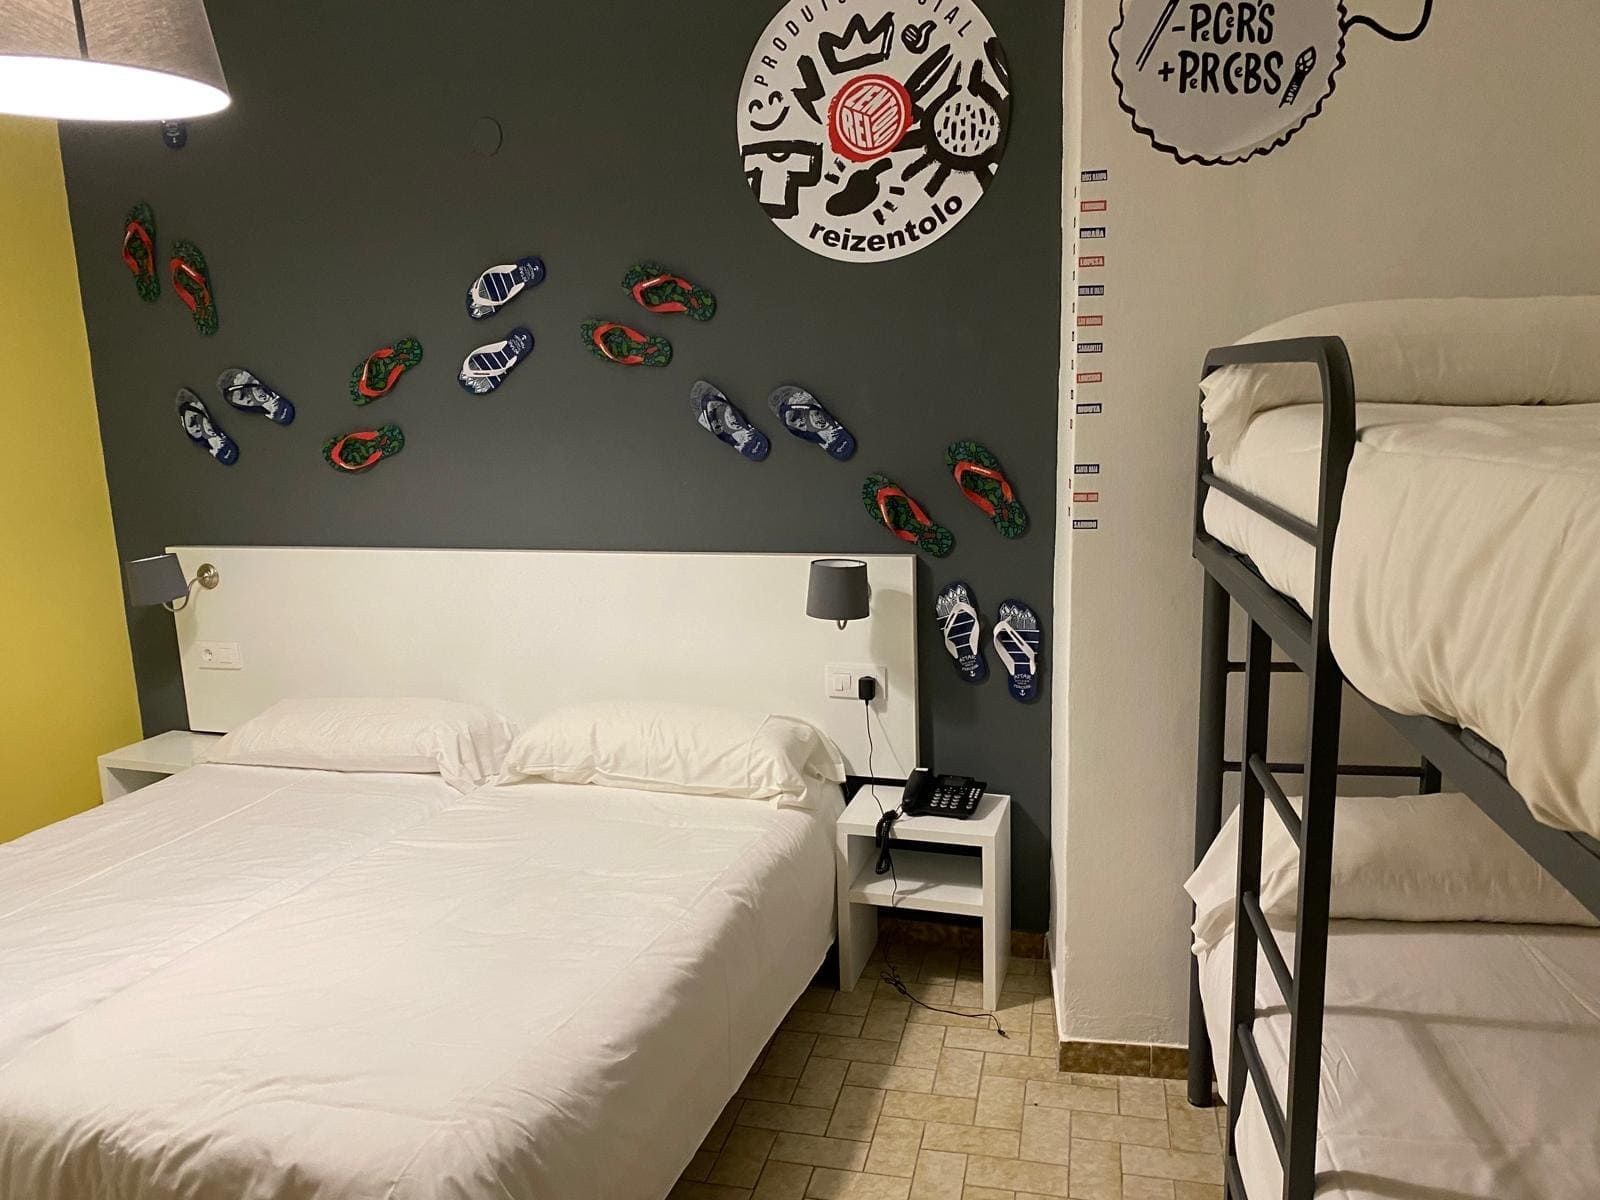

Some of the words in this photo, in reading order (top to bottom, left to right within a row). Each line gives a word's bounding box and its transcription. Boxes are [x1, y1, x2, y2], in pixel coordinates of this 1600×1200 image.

[753, 0, 846, 87] PRODU
[918, 0, 972, 38] IAL
[808, 195, 963, 253] reizentolo
